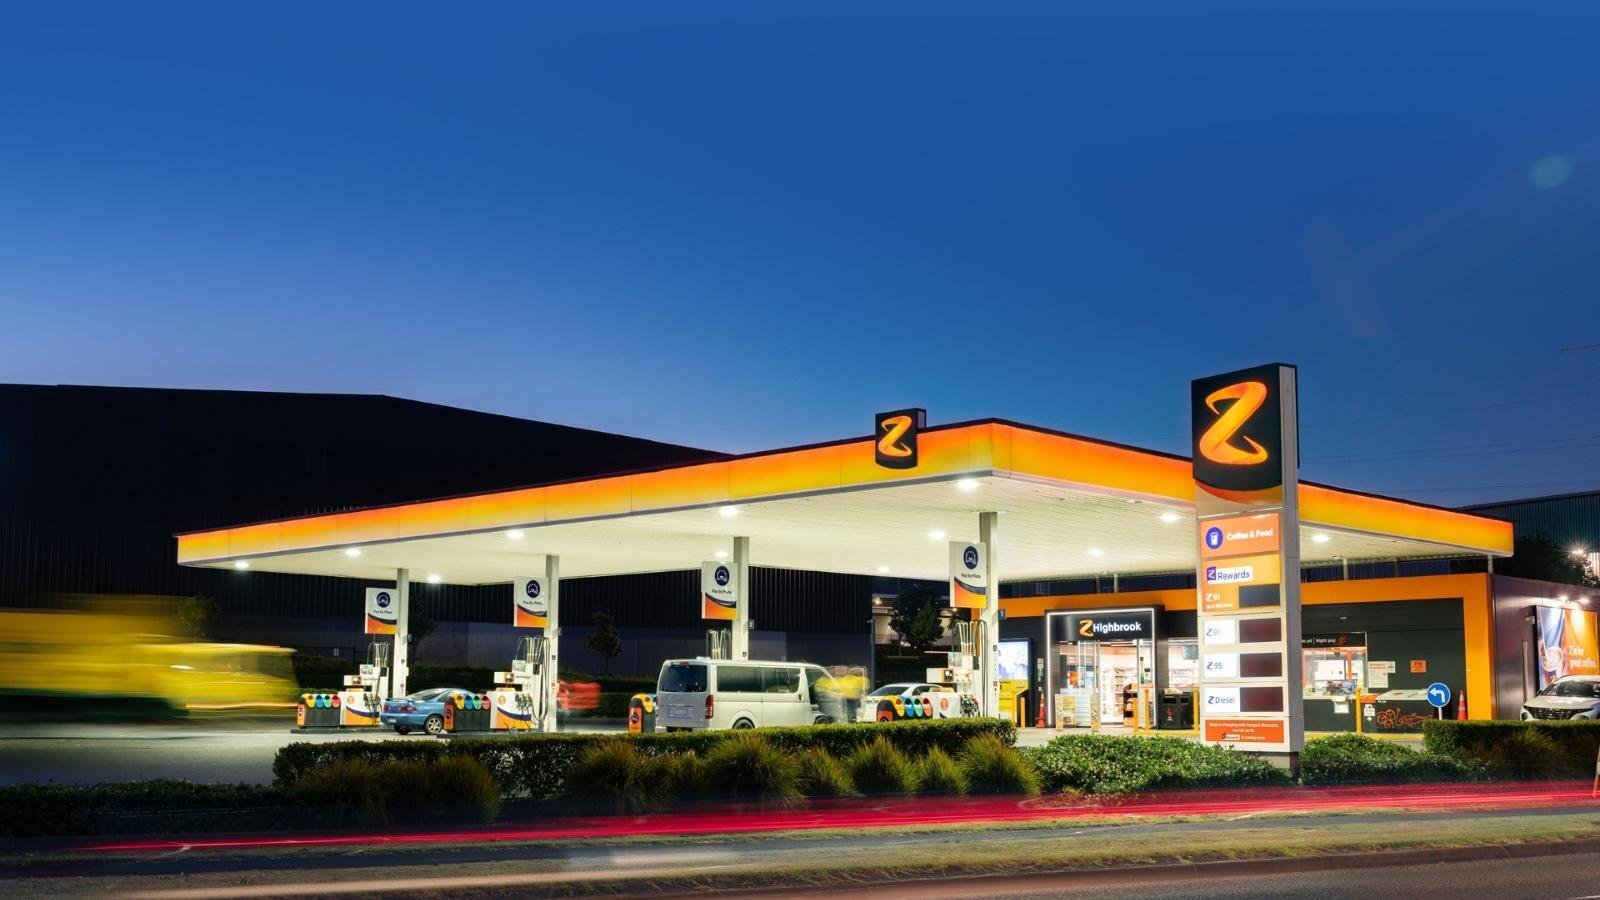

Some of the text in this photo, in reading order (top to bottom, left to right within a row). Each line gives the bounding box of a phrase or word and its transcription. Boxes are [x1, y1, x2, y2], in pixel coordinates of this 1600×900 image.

[1200, 382, 1268, 465] Z
[878, 415, 912, 457] Z
[1227, 532, 1248, 540] Coffee
[1256, 529, 1273, 538] Food
[1217, 570, 1250, 580] Rewards
[1093, 621, 1142, 634] Highbrook
